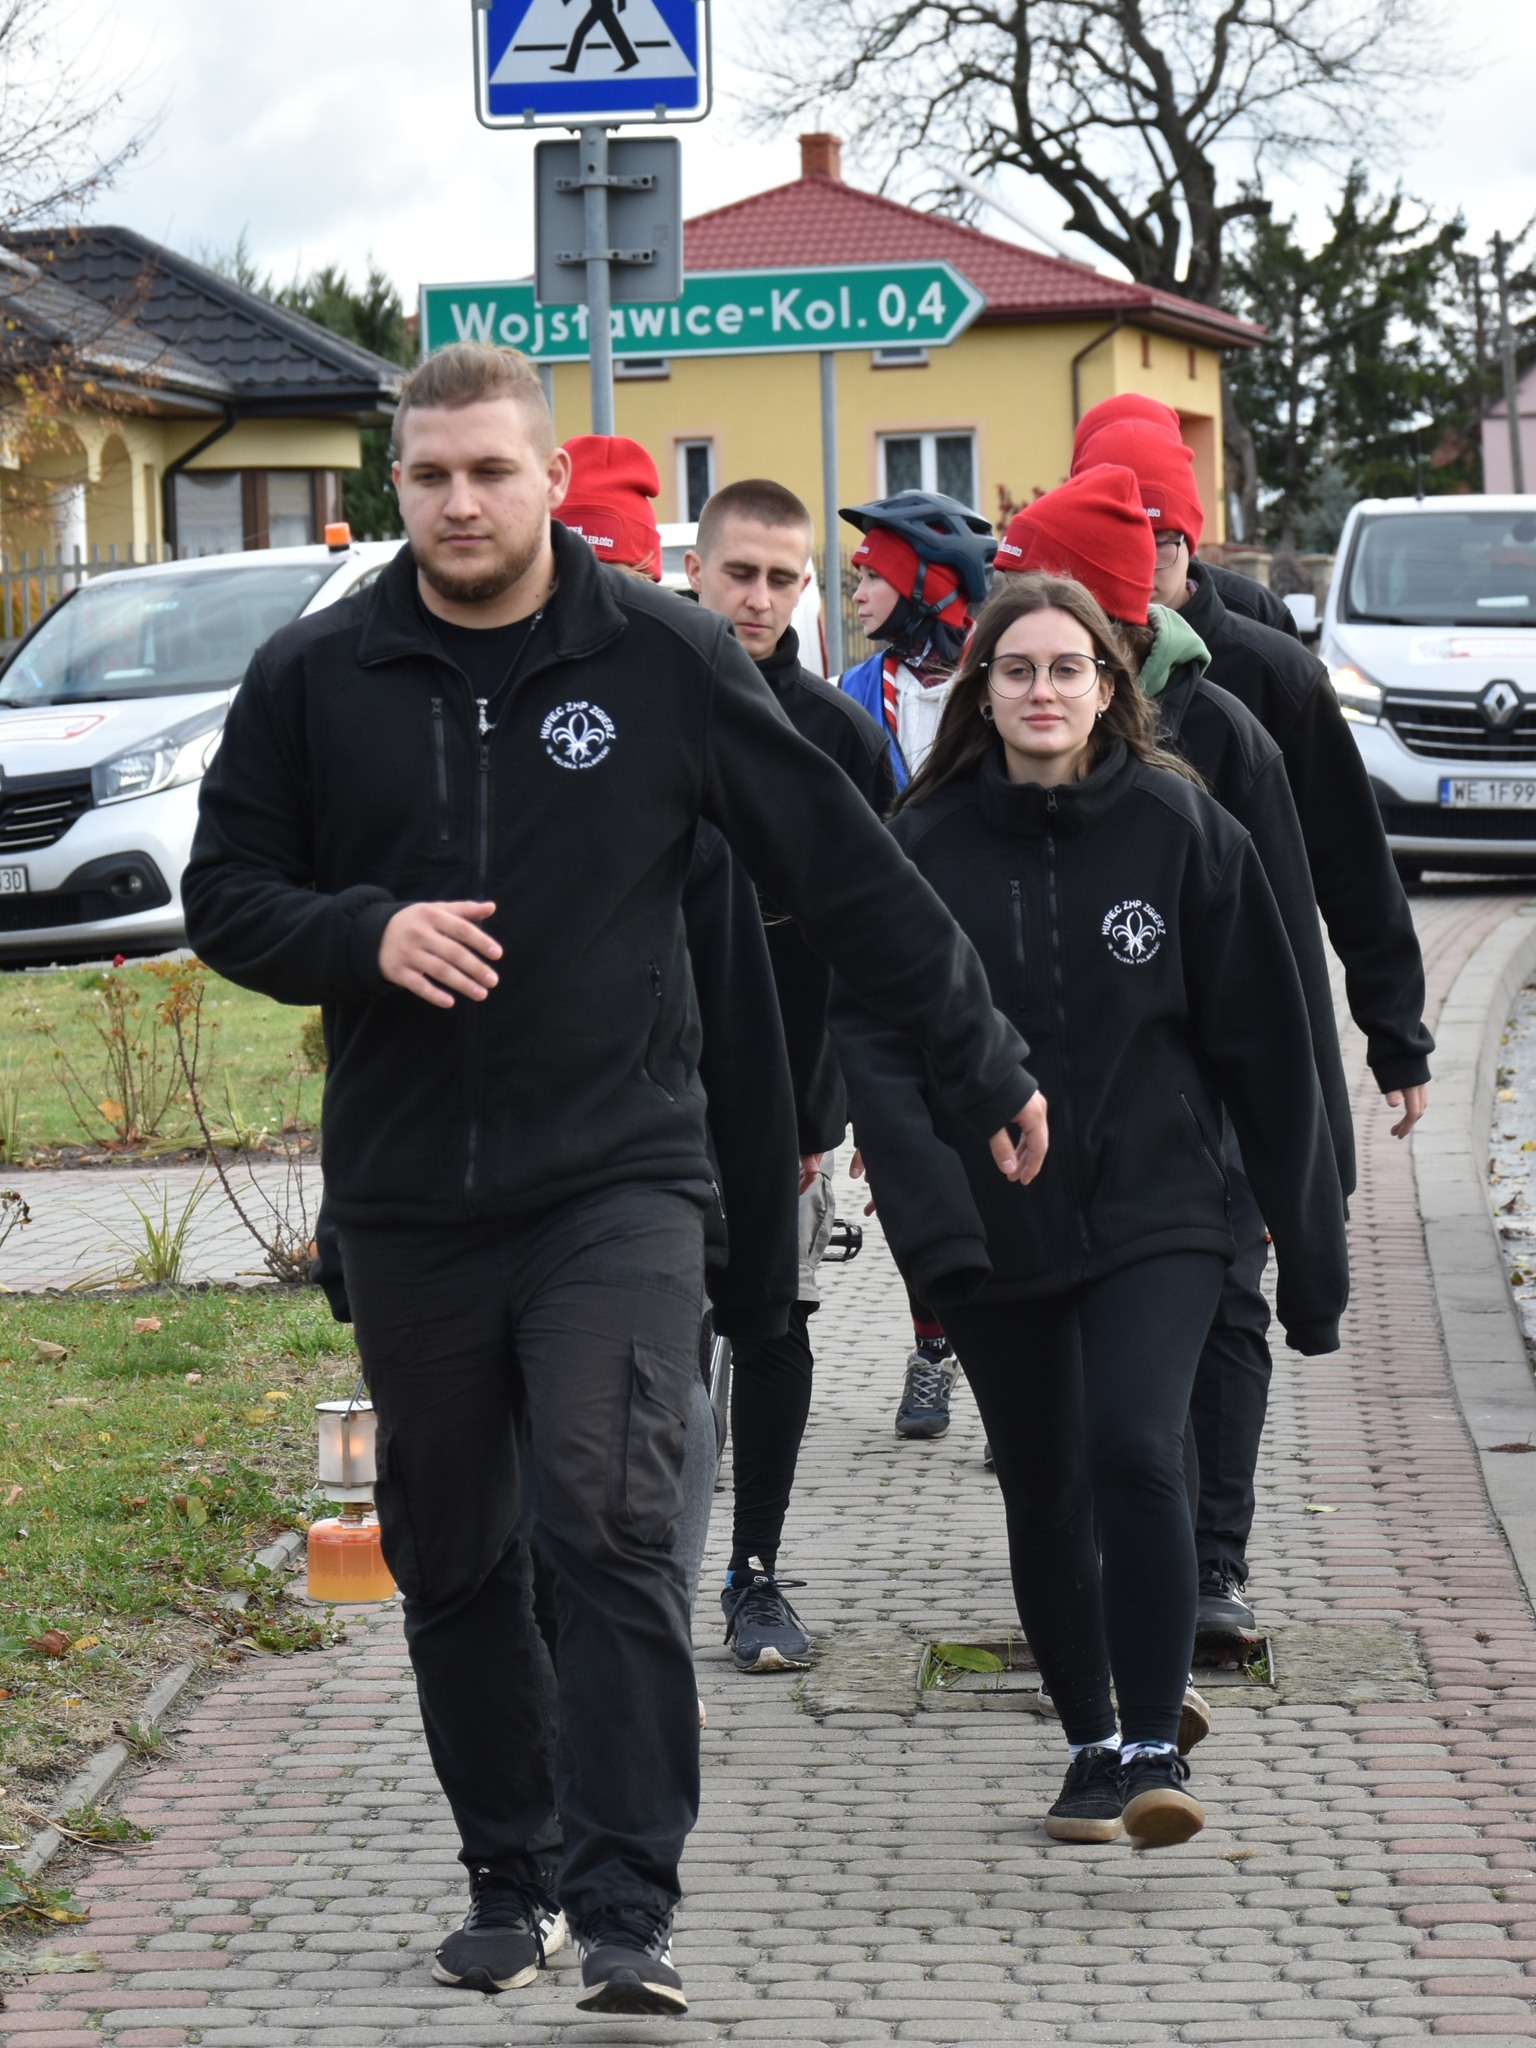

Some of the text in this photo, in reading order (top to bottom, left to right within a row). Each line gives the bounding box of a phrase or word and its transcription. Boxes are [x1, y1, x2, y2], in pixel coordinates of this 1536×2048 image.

[878, 281, 946, 332] 0,4
[540, 701, 617, 740] HUFIEC ZHP ZGIERZ
[1454, 783, 1478, 802] WE
[1101, 900, 1167, 936] HUFIEC ZHP ZGIERZ
